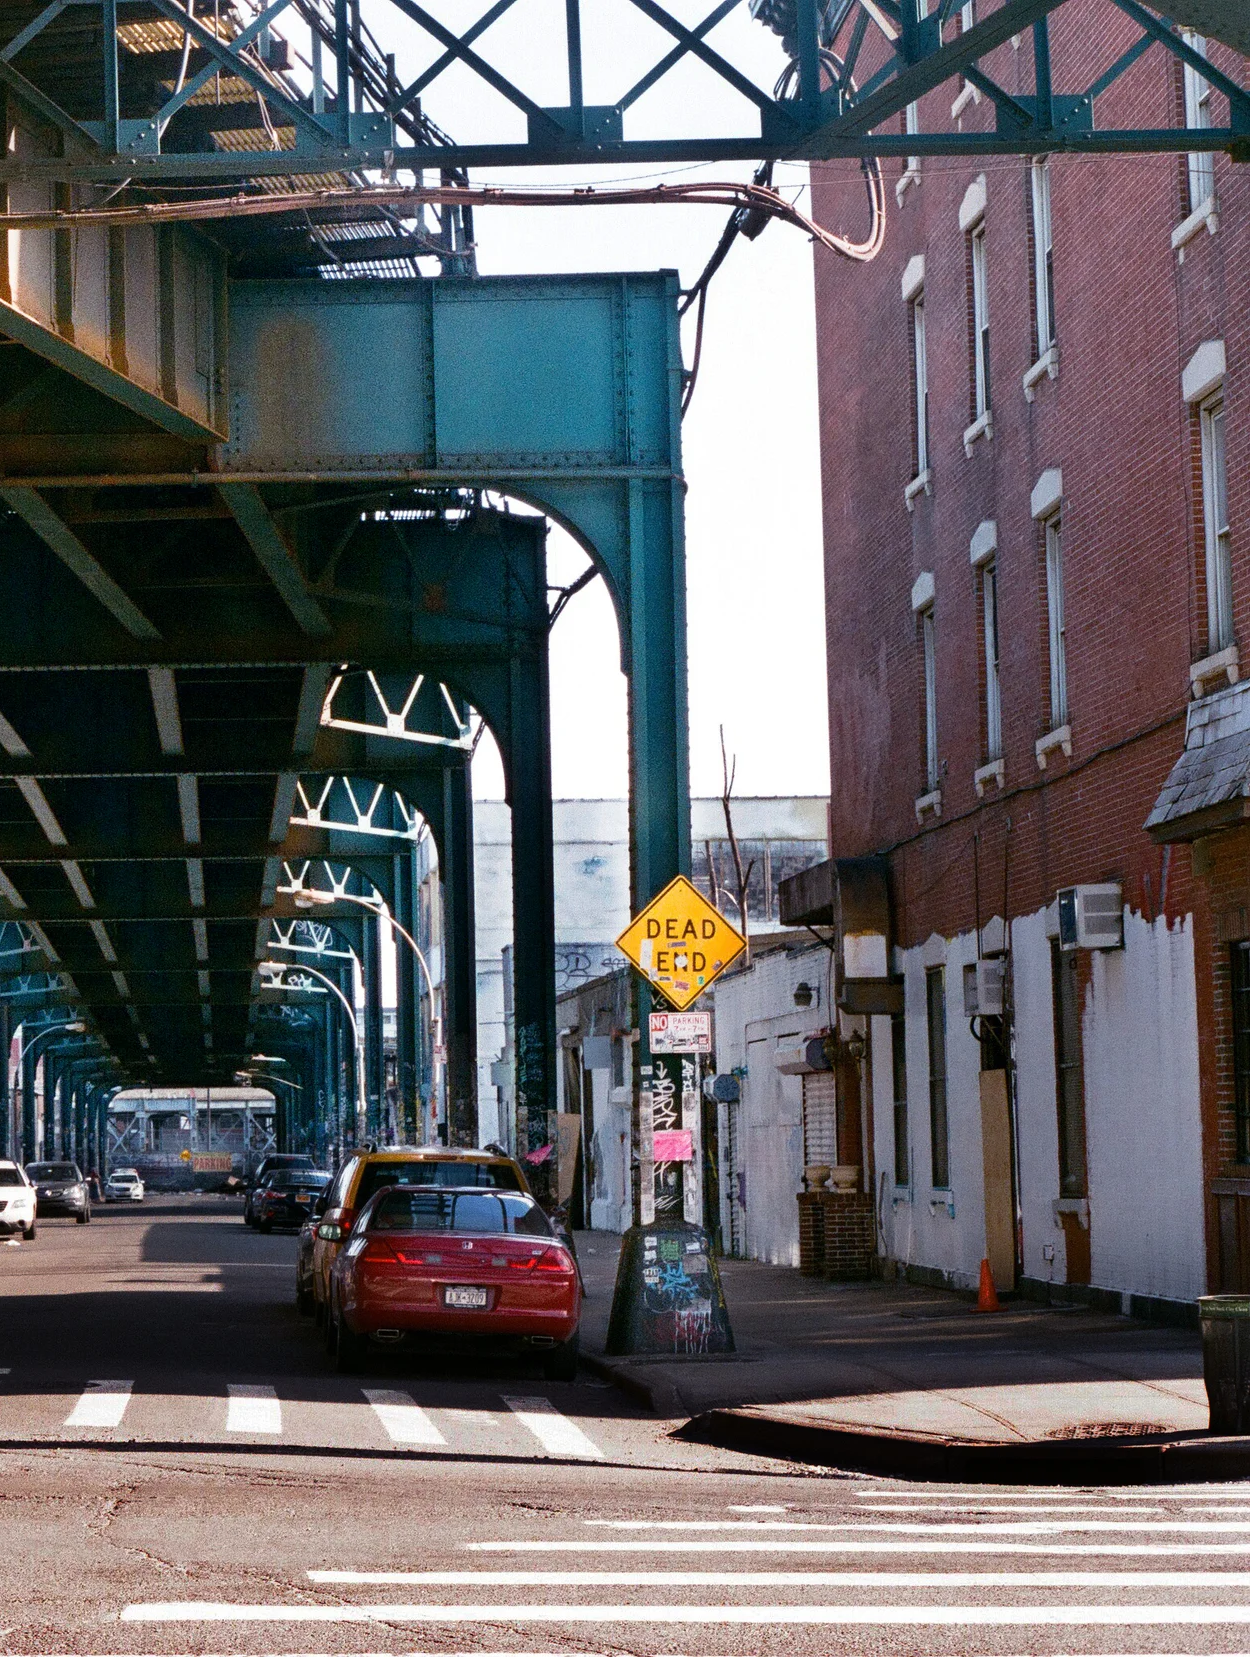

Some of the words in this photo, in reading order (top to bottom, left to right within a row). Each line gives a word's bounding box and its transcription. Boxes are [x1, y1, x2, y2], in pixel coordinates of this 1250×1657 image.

[646, 918, 716, 939] DEAD
[656, 951, 707, 972] END
[651, 1015, 668, 1030] NO
[672, 1017, 705, 1025] PARKING
